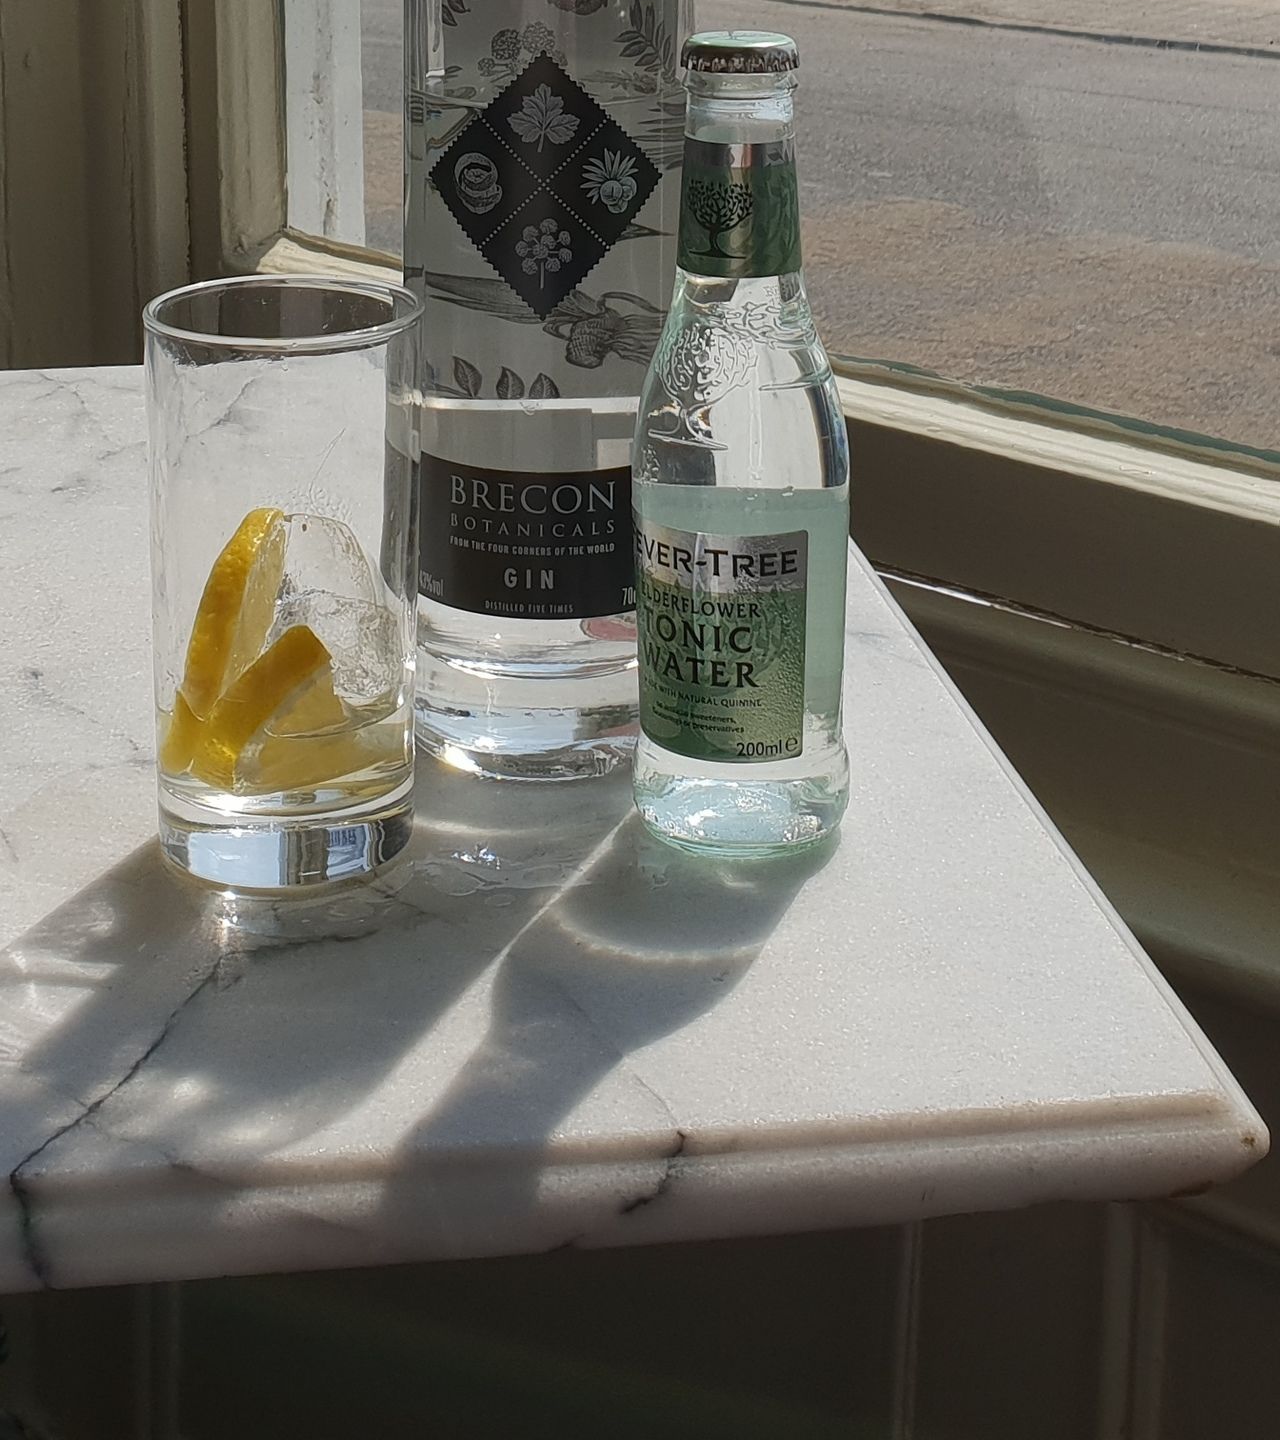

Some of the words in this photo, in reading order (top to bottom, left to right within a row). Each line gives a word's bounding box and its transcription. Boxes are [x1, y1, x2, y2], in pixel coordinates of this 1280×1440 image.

[450, 474, 615, 514] BRECON
[450, 513, 615, 538] BOTANICALS
[450, 535, 470, 548] FROM
[472, 540, 486, 552] THE
[488, 543, 509, 554] FOUR
[512, 546, 552, 556] CORNERS
[555, 546, 566, 556] OF
[569, 546, 584, 556] THE
[587, 542, 615, 554] WORLD
[632, 526, 797, 578] EVER-TREE
[504, 567, 555, 590] GIN
[485, 599, 525, 613] DISTILLED
[528, 604, 546, 614] FIVE
[549, 604, 574, 615] TIMES
[641, 579, 761, 618] ELDERFLOWER
[644, 604, 753, 654] TONIC
[644, 642, 759, 689] WATER
[678, 691, 718, 707] NATURAL
[720, 698, 762, 709] QUININE
[736, 739, 783, 757] 200ml
